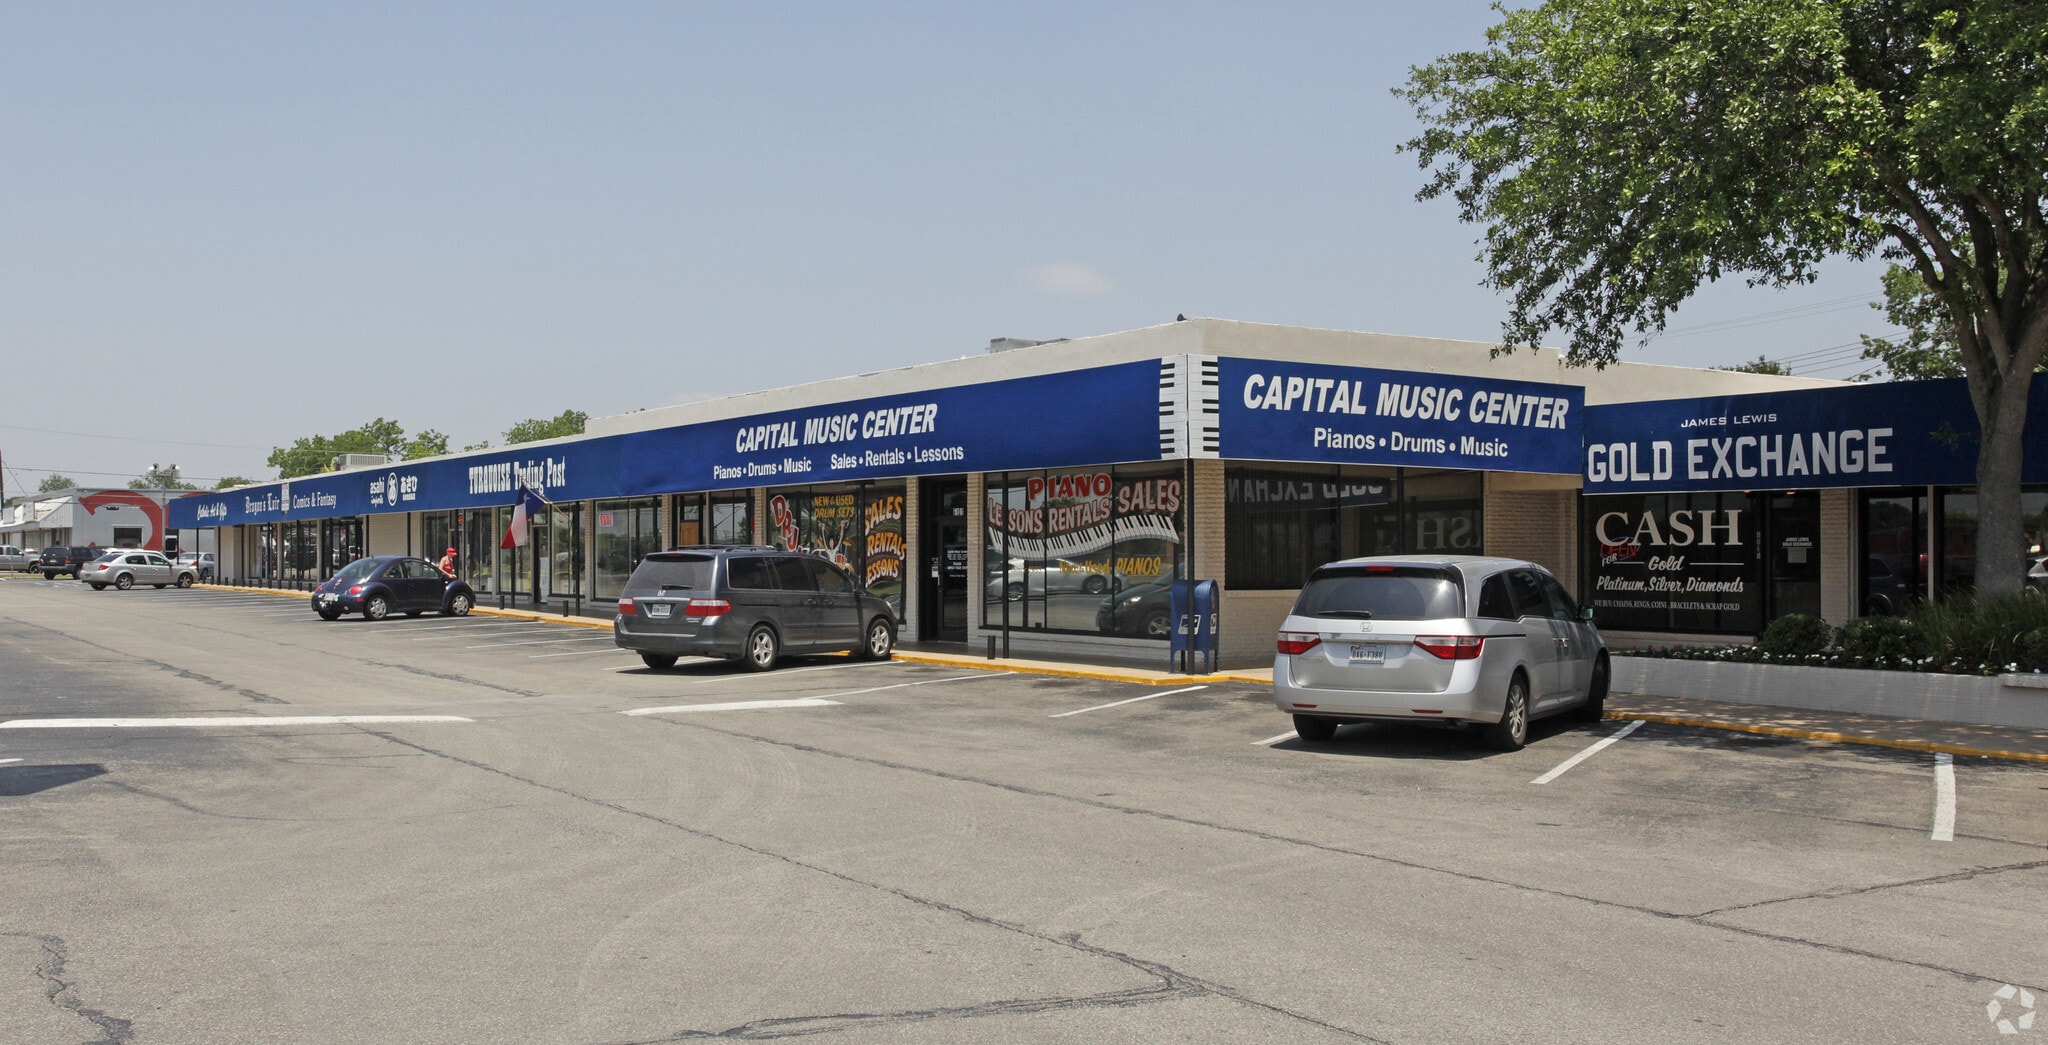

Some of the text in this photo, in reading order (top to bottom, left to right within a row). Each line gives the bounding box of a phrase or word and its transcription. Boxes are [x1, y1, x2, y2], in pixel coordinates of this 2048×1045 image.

[1243, 373, 1570, 429] CAPITAL MUSIC CENTER
[736, 403, 938, 453] CAPITAL MUSIC CENTER
[1680, 413, 1777, 429] JAMES LEWIS
[1313, 426, 1508, 458] Pianos Drums Music
[1588, 427, 1894, 483] GOLD EXCHANGE
[469, 456, 566, 497] TURQUOISE Trading Post
[713, 445, 964, 480] Pianos Drums Music Sales Rentals Lessons
[292, 494, 311, 509] Comics
[311, 491, 316, 507] &
[316, 491, 337, 509] Fantasy
[814, 496, 829, 506] NEW
[836, 495, 854, 506] USED
[1027, 472, 1113, 501] PIANO
[814, 507, 856, 518] DRUM SETS
[988, 479, 1181, 534] LESONS RENTALS SALES
[1595, 509, 1744, 547] CASH
[867, 532, 907, 560] RENTALS
[1601, 552, 1618, 567] FOR
[865, 558, 899, 588] ESSONS
[1115, 556, 1162, 575] PIANOS
[1647, 555, 1685, 571] Gold
[1596, 575, 1744, 593] Platinum, Silver, Diamonds
